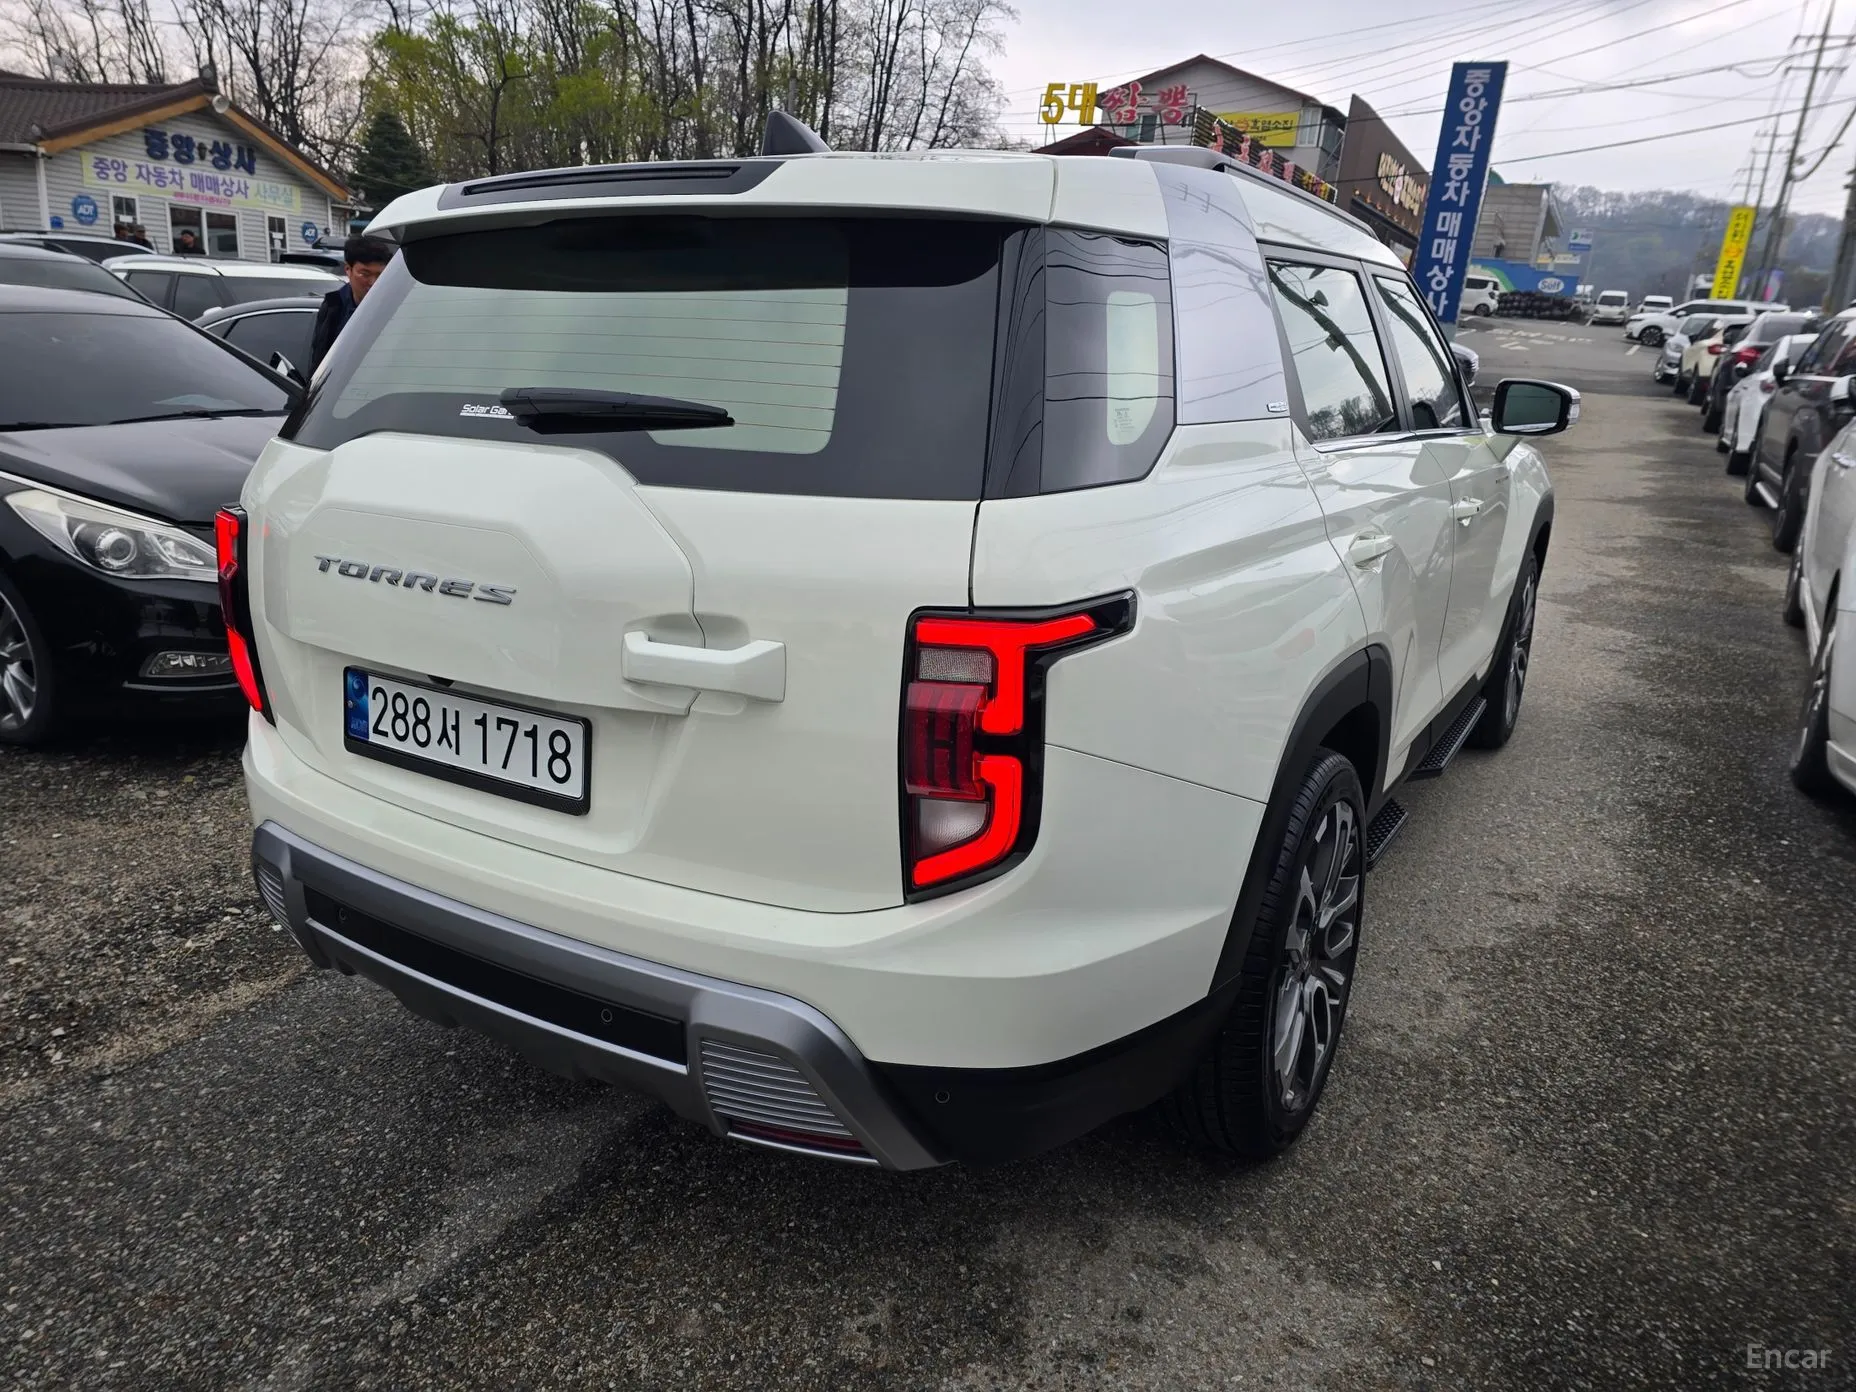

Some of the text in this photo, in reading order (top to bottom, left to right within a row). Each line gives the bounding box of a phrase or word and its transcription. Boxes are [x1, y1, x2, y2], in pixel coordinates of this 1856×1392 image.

[1042, 83, 1098, 126] 5대
[92, 156, 128, 183] 중앙
[135, 163, 185, 190] 자동차
[190, 172, 249, 200] 매매상사
[461, 404, 490, 414] Solar
[314, 555, 517, 606] TORRES
